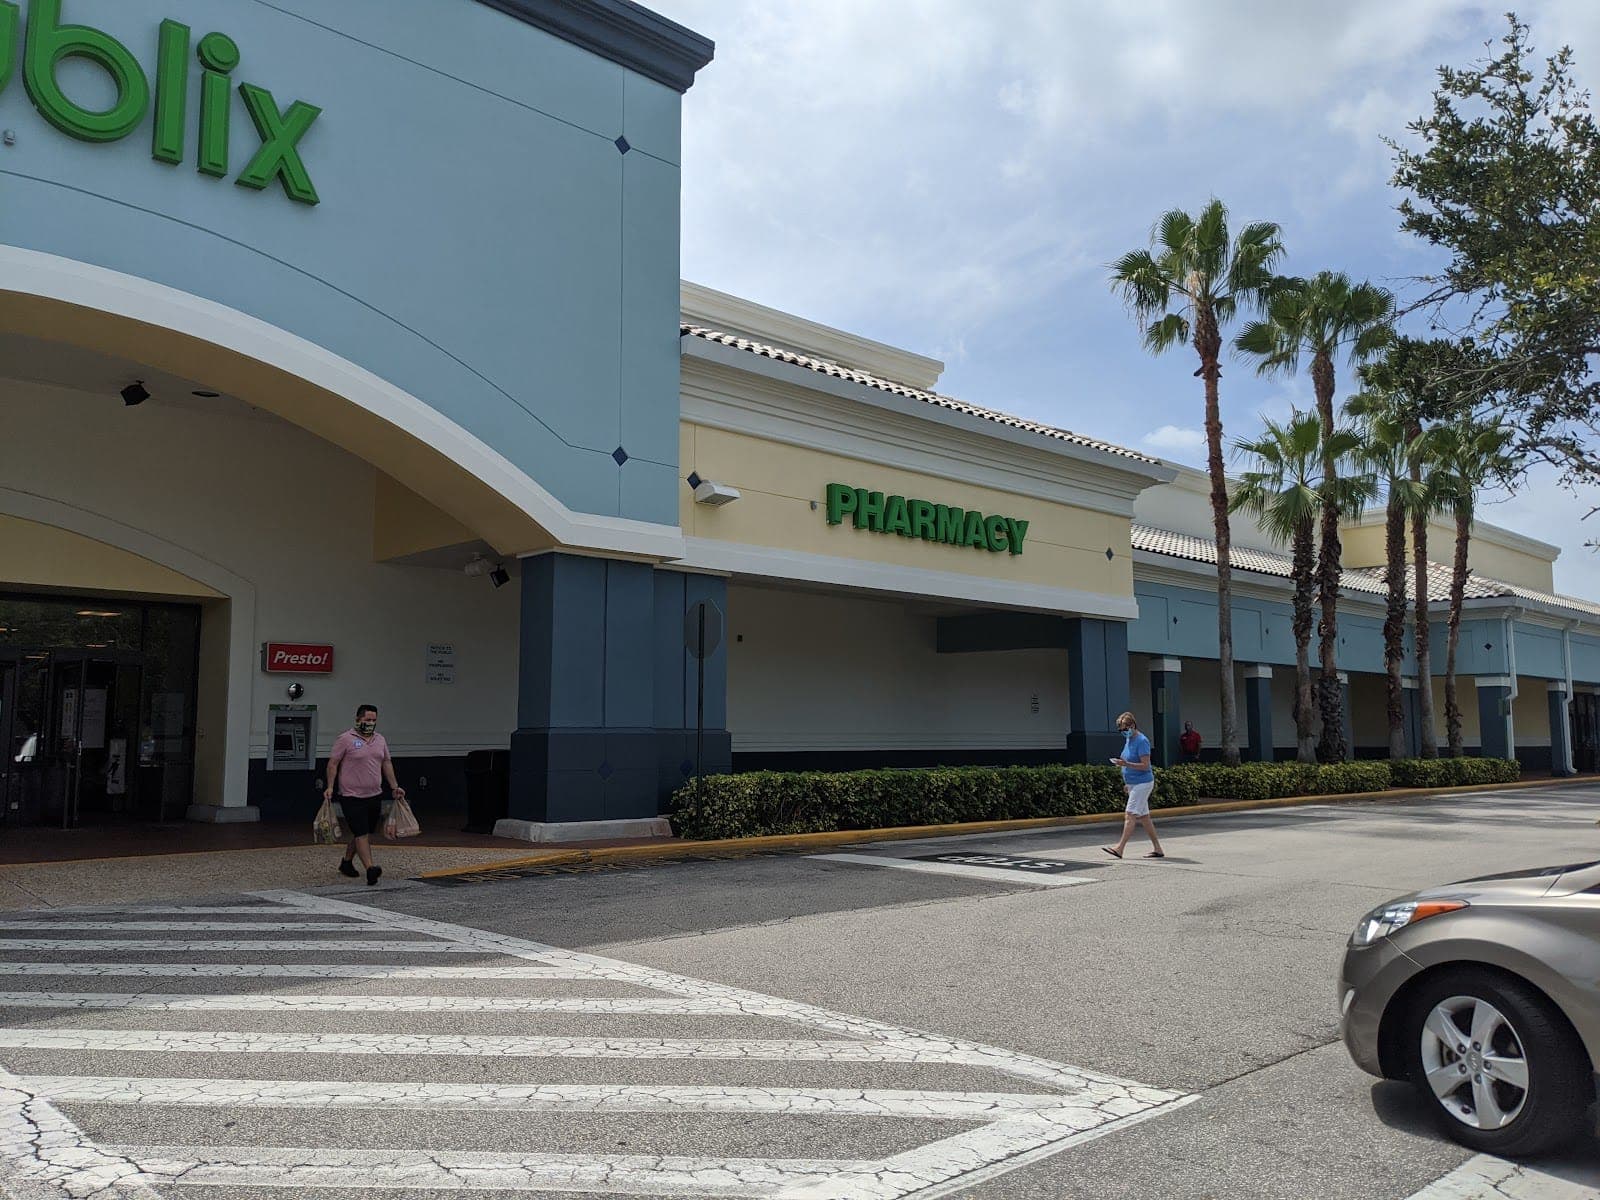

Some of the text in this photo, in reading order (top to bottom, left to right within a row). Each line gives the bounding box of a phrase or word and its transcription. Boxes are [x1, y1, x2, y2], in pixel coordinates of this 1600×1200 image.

[0, 0, 322, 205] blix
[826, 483, 1029, 555] PHARMACY
[273, 651, 328, 665] Presto!
